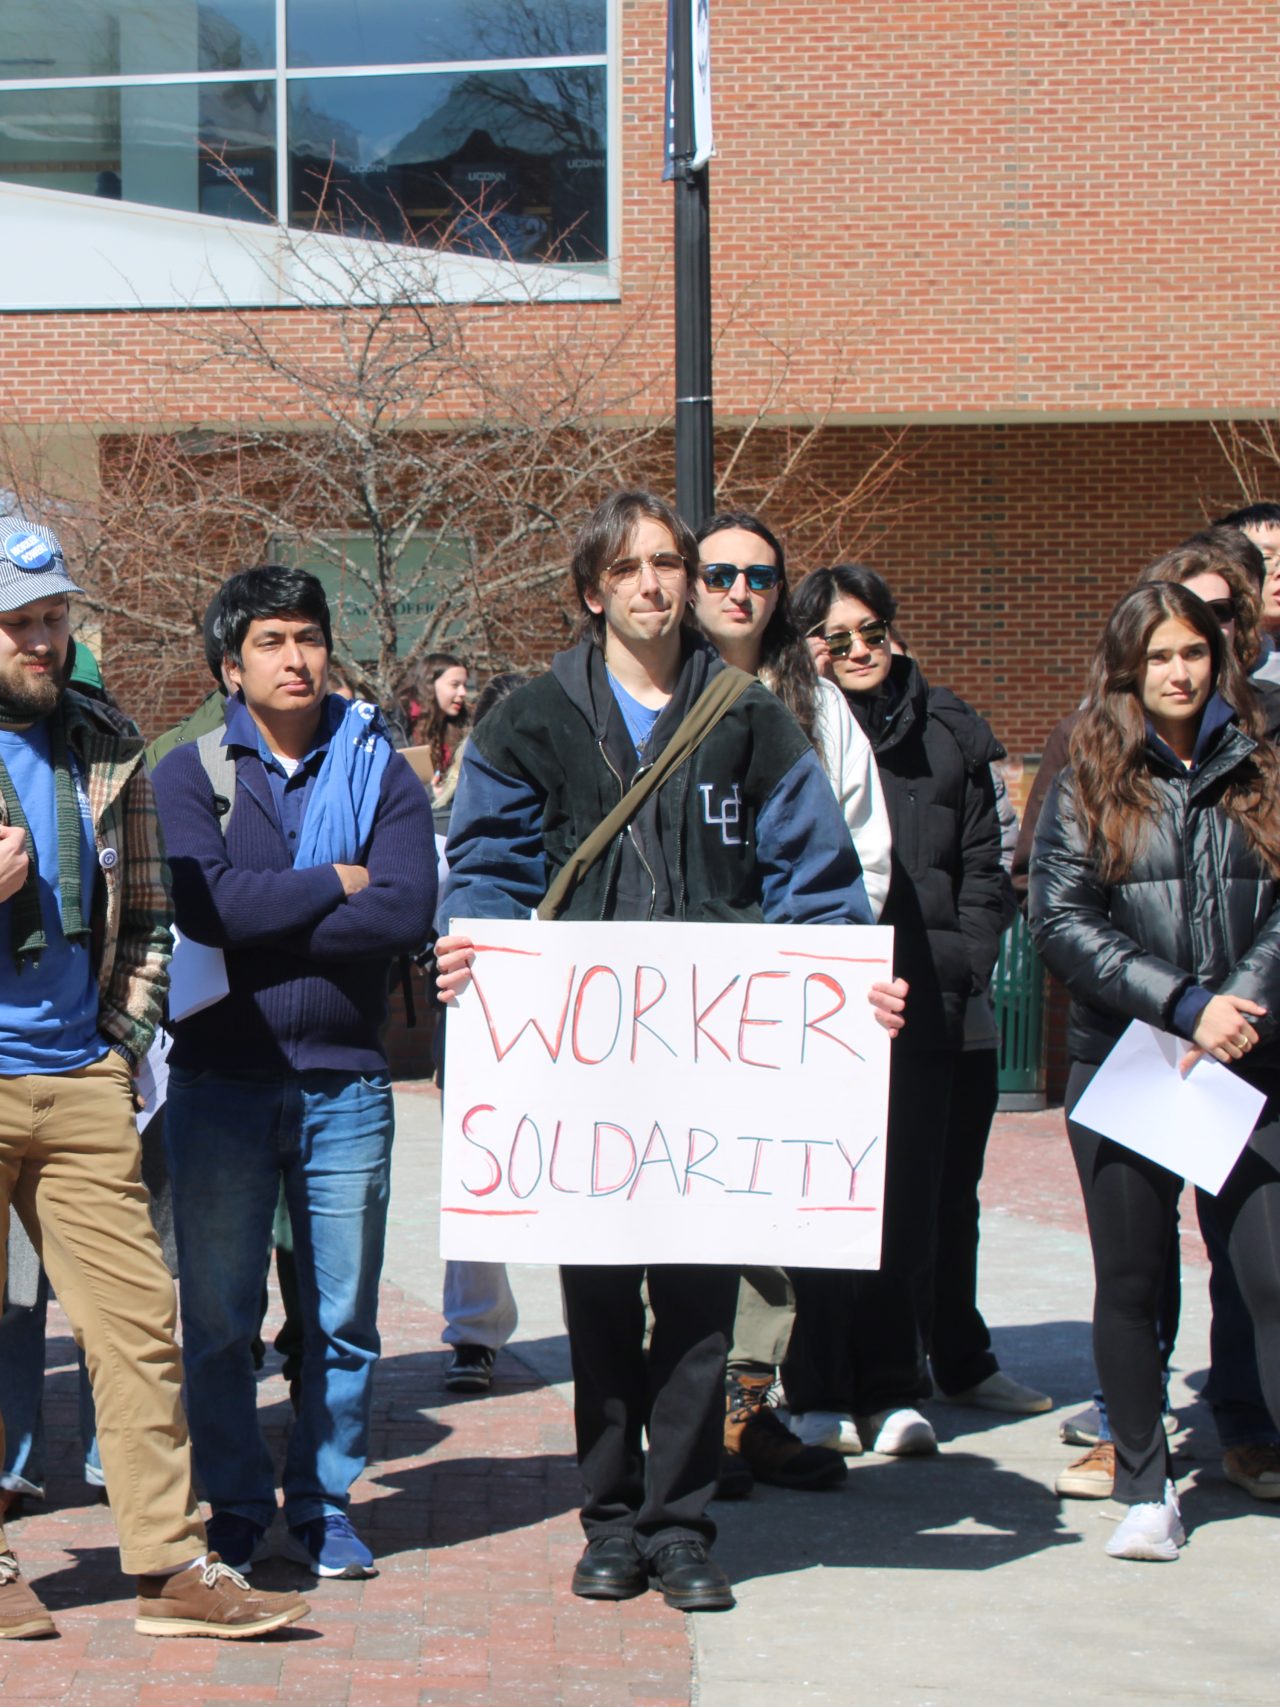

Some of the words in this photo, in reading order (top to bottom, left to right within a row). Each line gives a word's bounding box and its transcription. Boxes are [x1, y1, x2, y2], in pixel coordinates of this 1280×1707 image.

[468, 171, 506, 181] UCONN
[567, 159, 605, 169] UCONN
[465, 960, 865, 1070] WORKER
[461, 1104, 878, 1201] SOLDARITY
